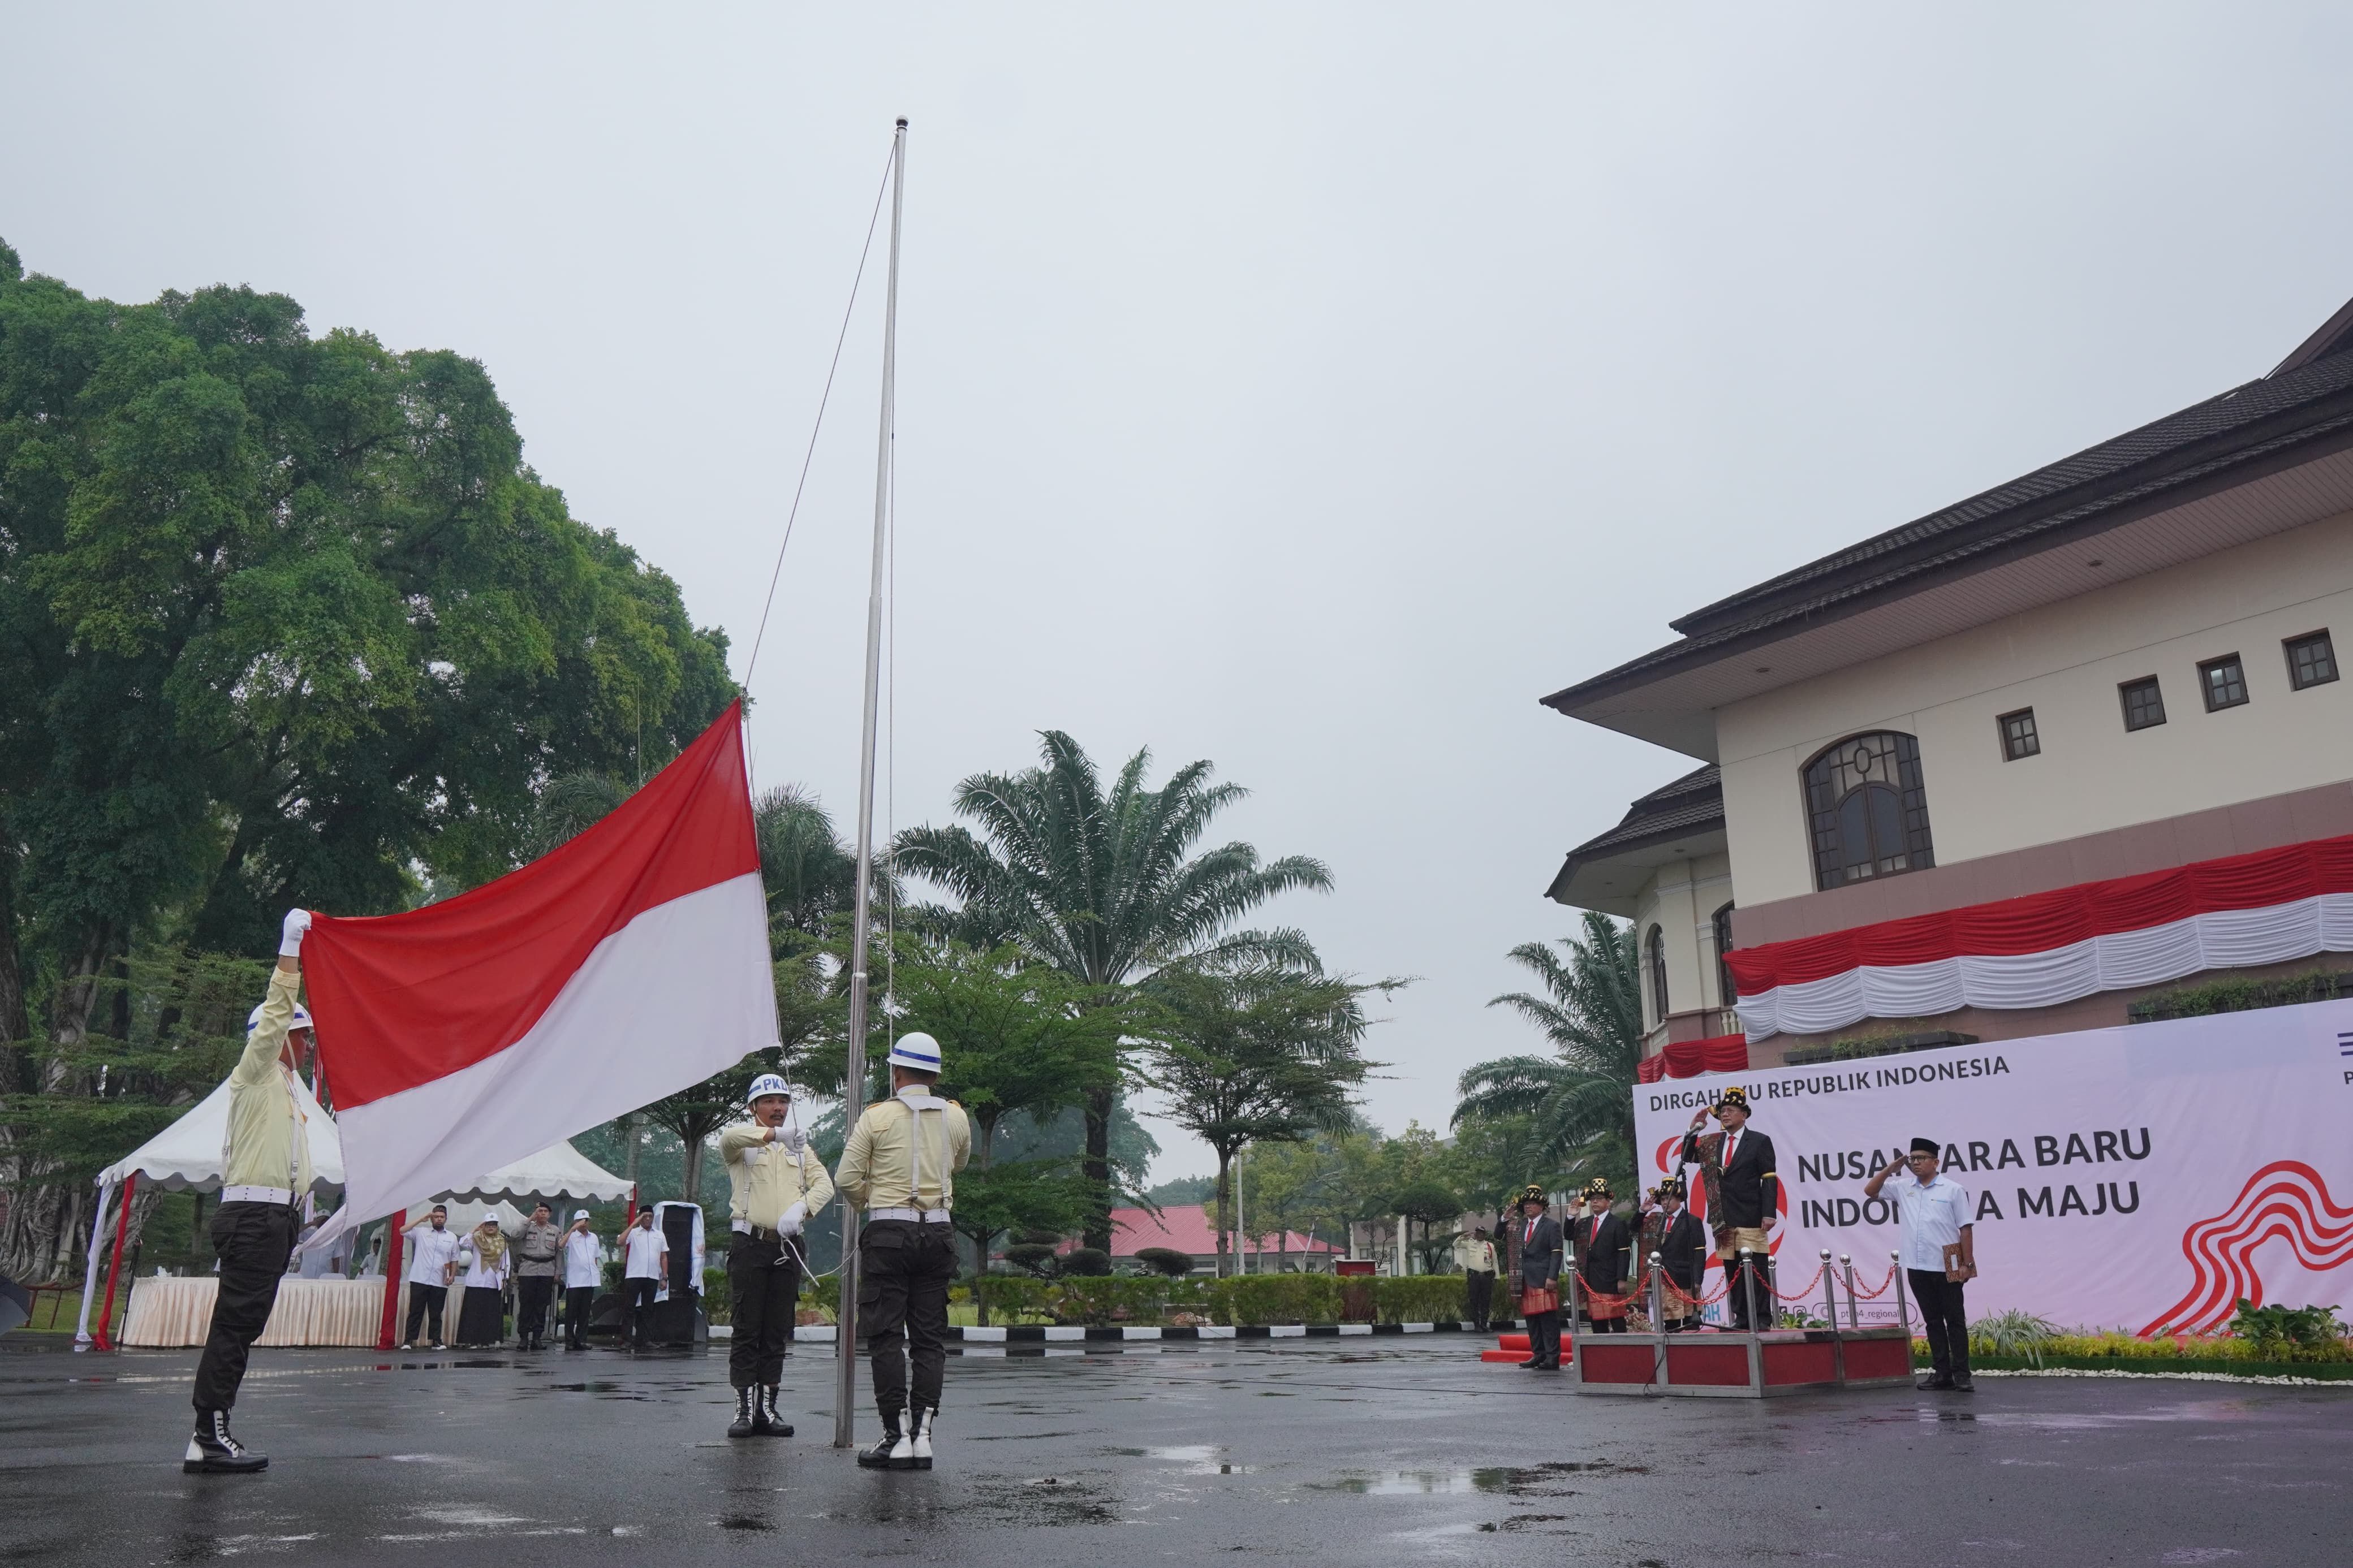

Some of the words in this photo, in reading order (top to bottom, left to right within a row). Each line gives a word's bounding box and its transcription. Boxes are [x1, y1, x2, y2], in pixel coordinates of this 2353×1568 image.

[1650, 1084, 1761, 1112] DIRGAHU
[1768, 1072, 1871, 1099] REPUBLIK
[1877, 1056, 2010, 1087] INDONESIA
[1798, 1139, 2026, 1182] NUSANARA
[2034, 1127, 2151, 1167] BARU
[1802, 1190, 2003, 1228] INDOA
[2017, 1181, 2140, 1218] MAJU
